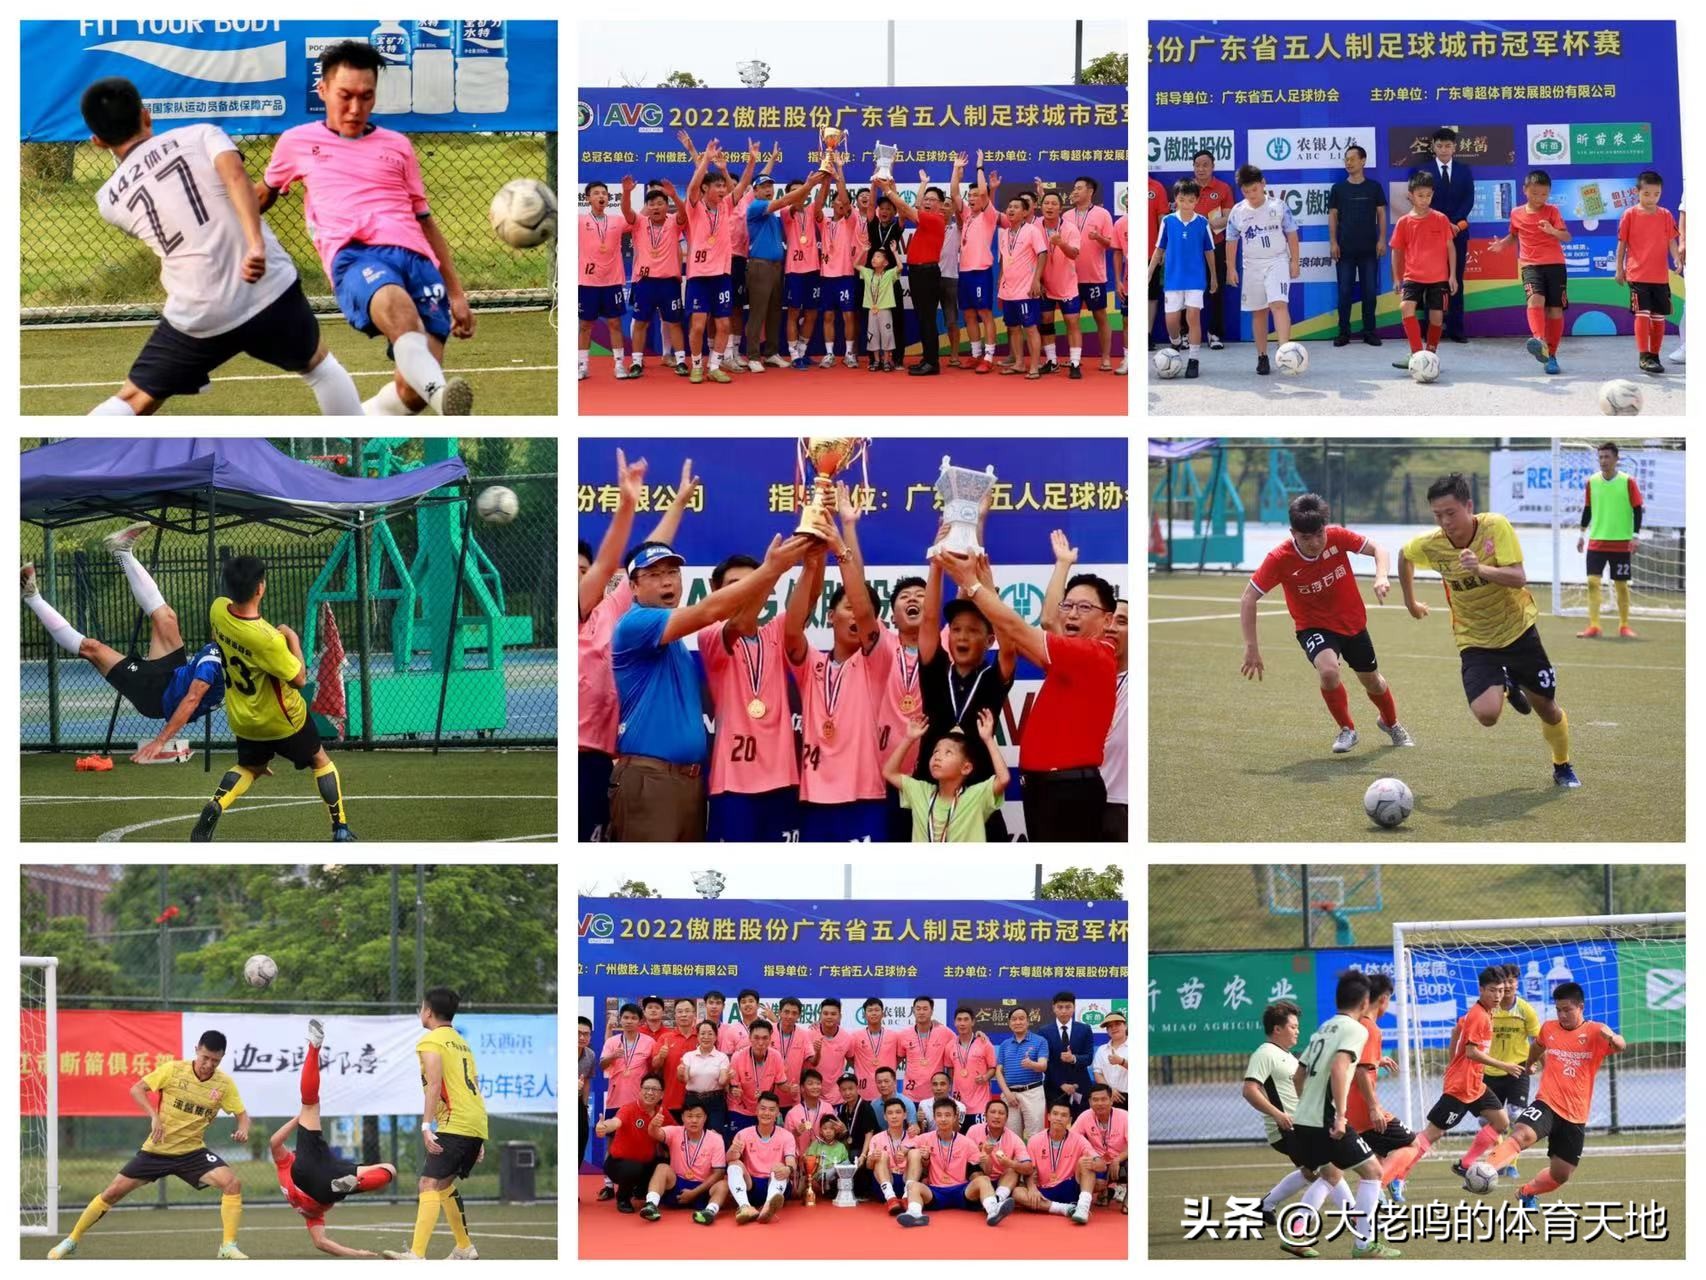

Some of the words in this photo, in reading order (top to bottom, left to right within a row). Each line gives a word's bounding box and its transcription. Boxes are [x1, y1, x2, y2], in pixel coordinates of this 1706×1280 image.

[603, 102, 664, 127] AVG
[126, 155, 209, 256] 27
[1617, 563, 1630, 575] 22
[1306, 633, 1325, 653] 53
[731, 736, 757, 762] 20
[1418, 983, 1456, 996] BODY
[1162, 1022, 1197, 1032] MIAO
[1203, 1020, 1264, 1031] AGRICUL
[1524, 1105, 1542, 1121] 20
[206, 1152, 217, 1163] 6
